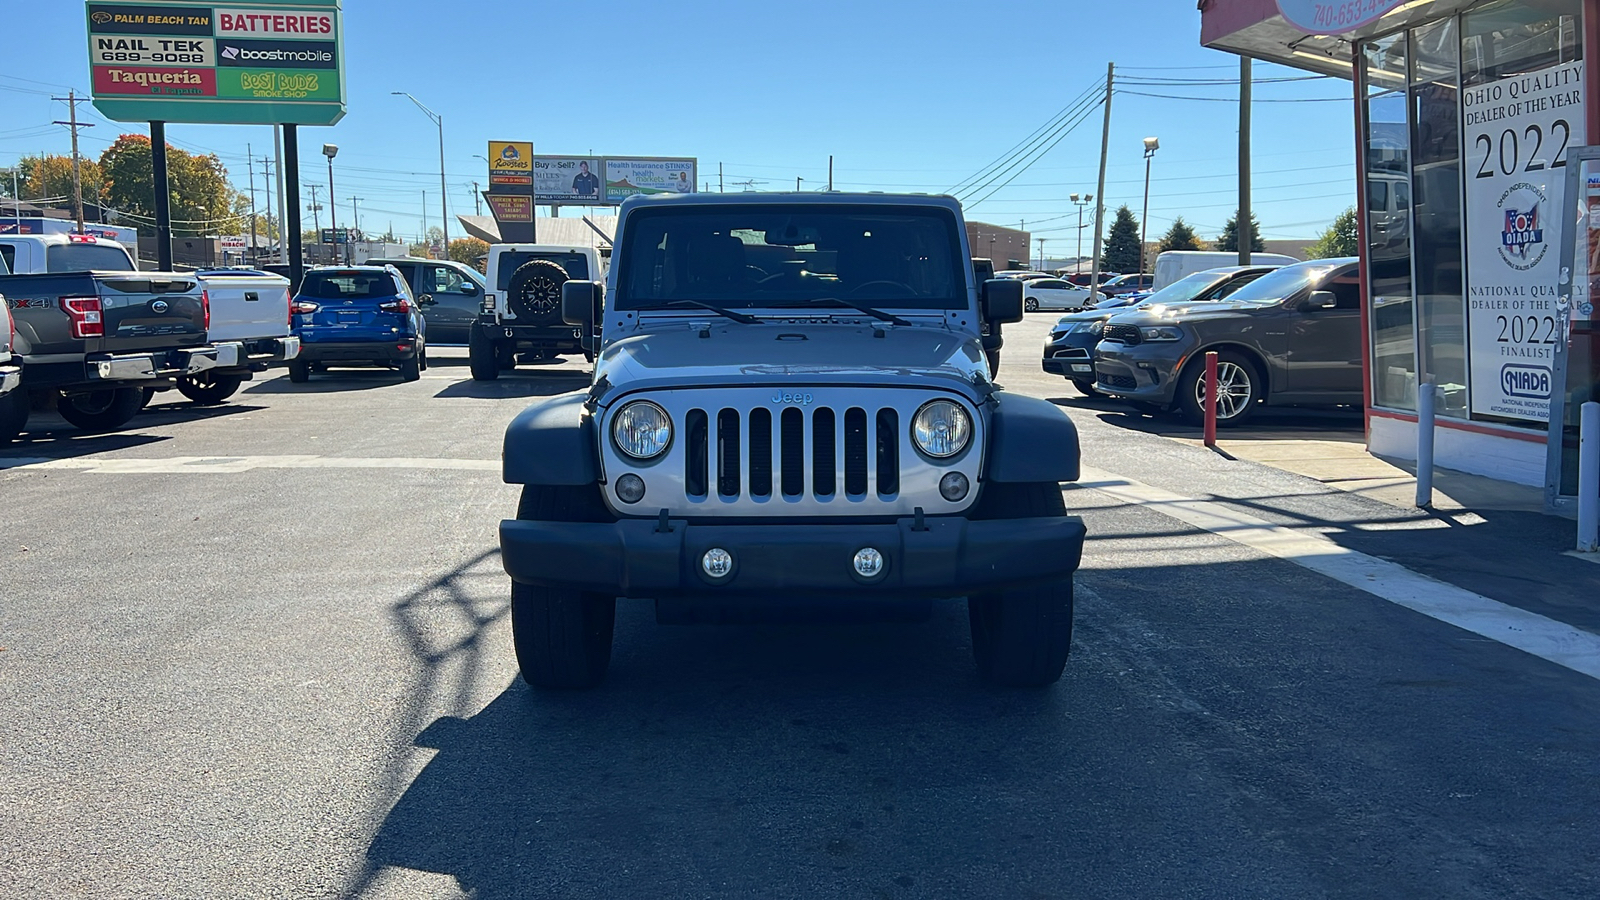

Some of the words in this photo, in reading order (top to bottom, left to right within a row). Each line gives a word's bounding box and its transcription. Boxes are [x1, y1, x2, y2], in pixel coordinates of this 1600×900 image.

[114, 14, 144, 24] PALM
[147, 15, 184, 25] BEACH
[187, 16, 209, 26] TAN
[220, 13, 331, 34] BATTERIES
[98, 38, 149, 51] NAIL
[158, 40, 205, 53] TEK
[101, 51, 204, 63] 689-9088
[240, 48, 332, 62] boostmobile
[1464, 85, 1502, 107] OHIO
[1509, 65, 1583, 99] QUALITY
[252, 90, 282, 98] SMOKE
[284, 91, 307, 99] SHOP
[1466, 106, 1506, 126] DEALER
[1508, 102, 1522, 118] OF
[1525, 97, 1547, 114] THE
[1549, 90, 1581, 109] YEAR
[1475, 119, 1570, 179] 2022
[493, 158, 529, 169] Roosters
[535, 161, 550, 170] Buy
[557, 161, 576, 169] Sell?
[635, 175, 664, 183] markets
[1497, 190, 1509, 208] OHIO
[1509, 182, 1547, 203] INDEPENDENT
[1506, 233, 1536, 244] OIADA
[1471, 286, 1526, 296] NATIONAL
[1472, 301, 1508, 310] DEALER
[1512, 301, 1526, 310] OF
[1529, 301, 1550, 310] THE
[1496, 315, 1555, 344] 2022
[1501, 347, 1551, 359] FINALIST
[1505, 370, 1549, 392] NIADA
[771, 389, 813, 406] Jeep
